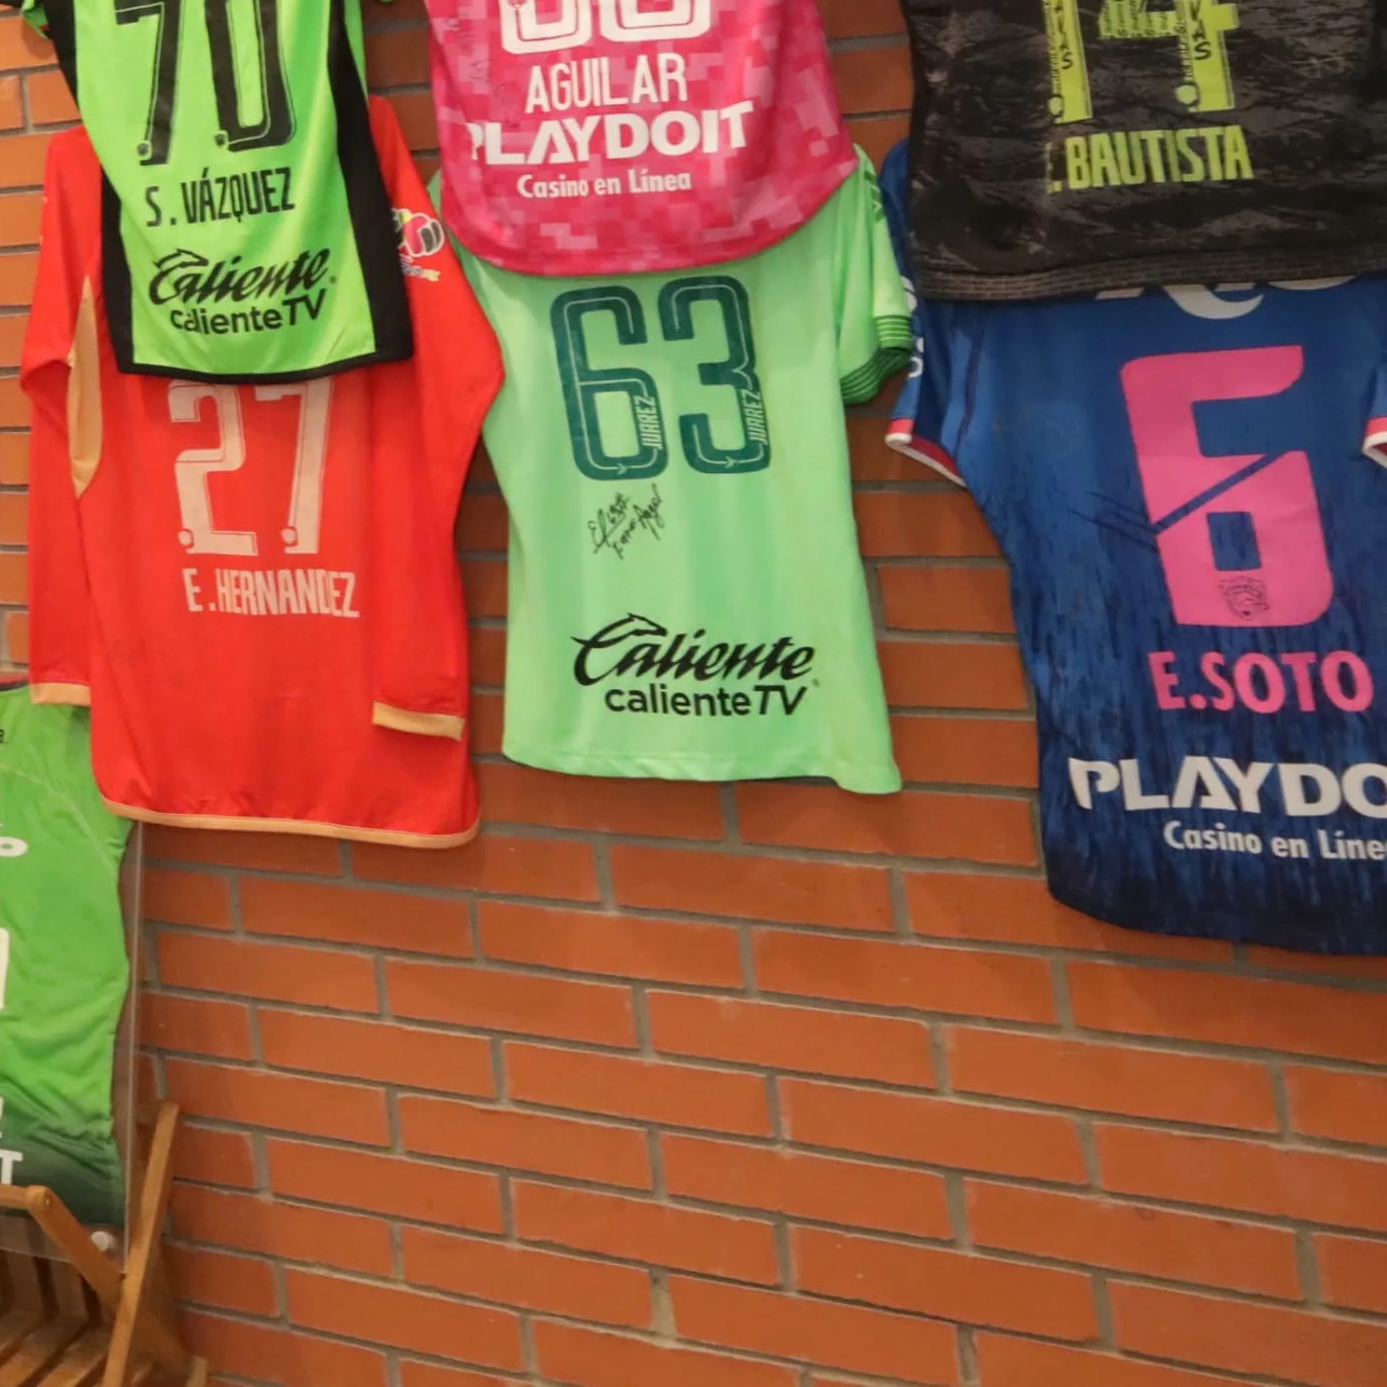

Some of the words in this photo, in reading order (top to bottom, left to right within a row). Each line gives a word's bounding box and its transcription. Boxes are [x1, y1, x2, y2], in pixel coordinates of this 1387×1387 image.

[524, 51, 689, 115] AGUILAR
[465, 100, 756, 167] PLAYDOIT
[1065, 124, 1254, 191] BAUTISTA
[146, 184, 178, 229] S.
[180, 166, 296, 231] VÁZQUEZ
[516, 172, 590, 200] Casino
[594, 177, 624, 196] en
[625, 165, 694, 194] Línea
[148, 246, 332, 306] Caliente
[549, 274, 772, 482] 63
[641, 394, 664, 452] JUAREZ
[746, 389, 768, 446] JUAREZ
[166, 377, 336, 557] 27
[1120, 344, 1334, 627] 6
[182, 567, 217, 613] E.
[216, 568, 360, 619] HERNANDEZ
[569, 612, 817, 688] Caliente
[1163, 819, 1264, 857] Casino
[1270, 832, 1309, 860] en
